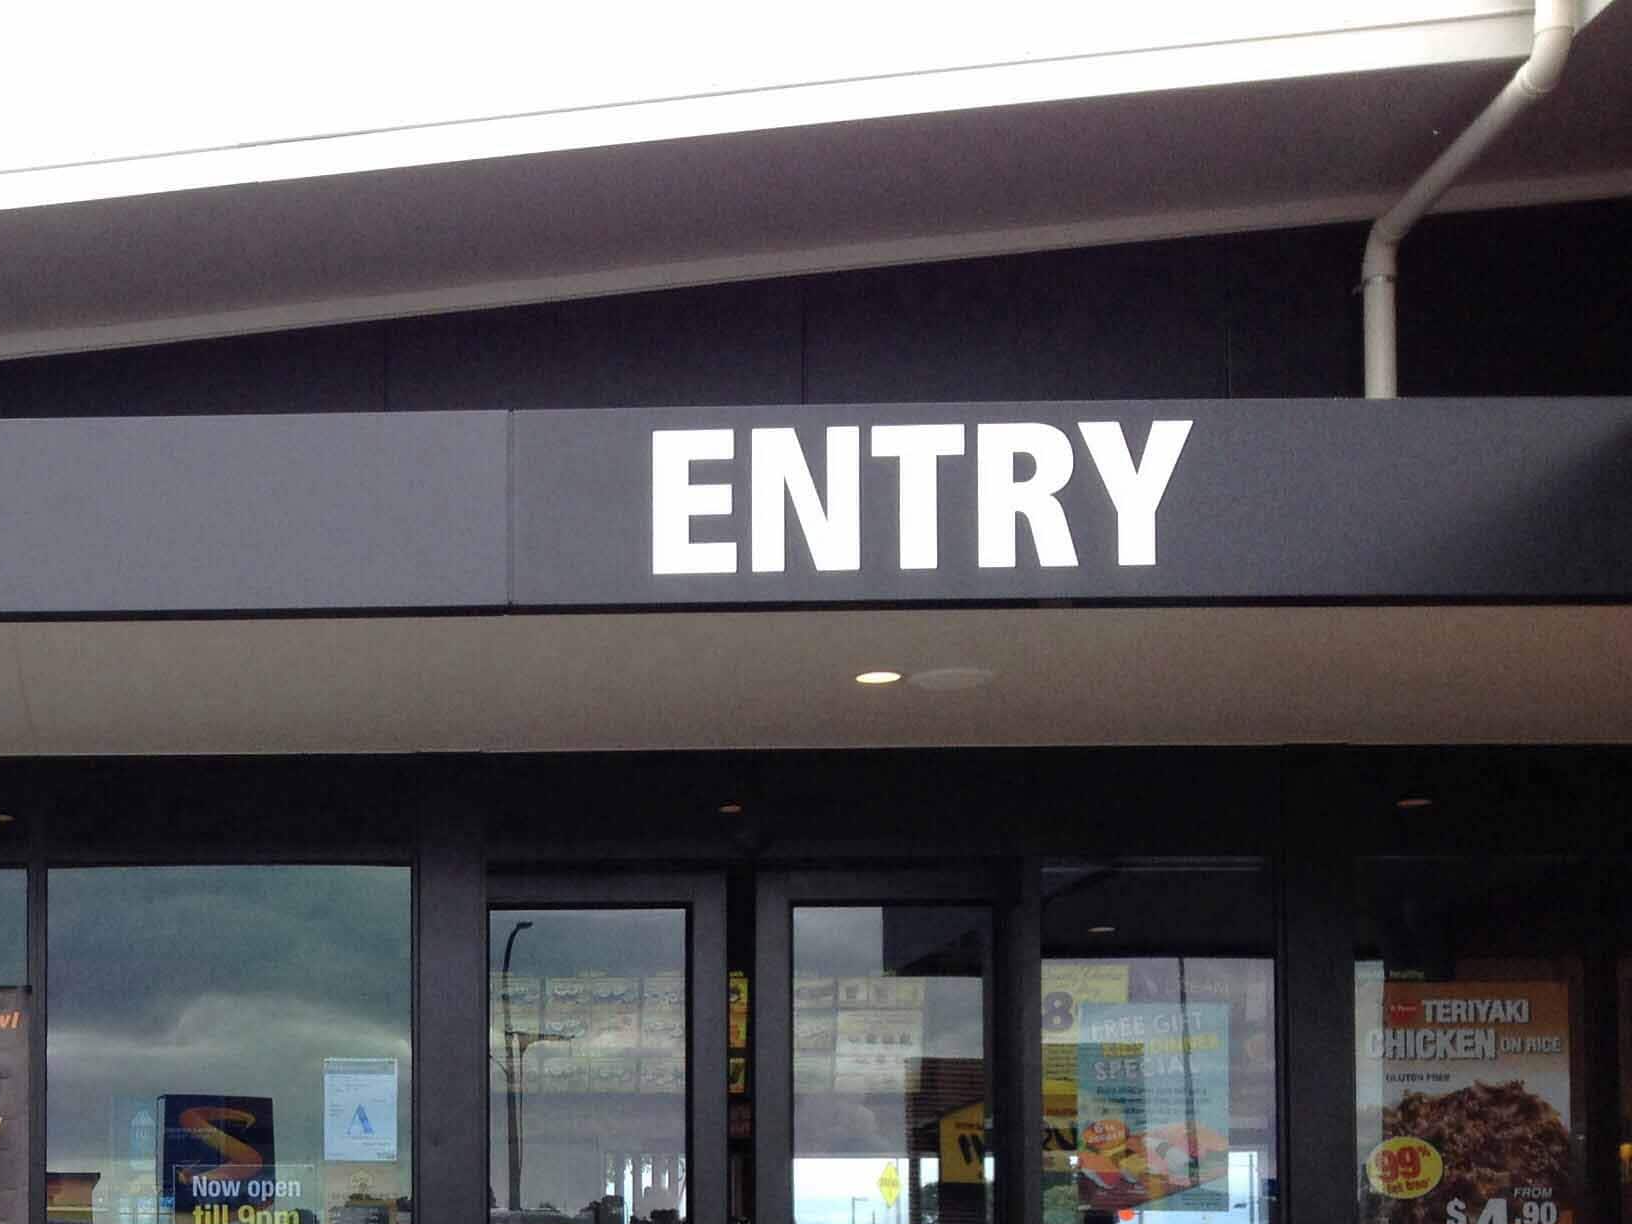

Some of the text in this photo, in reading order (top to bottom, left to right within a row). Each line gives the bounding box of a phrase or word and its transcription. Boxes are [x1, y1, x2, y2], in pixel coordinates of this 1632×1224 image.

[652, 420, 1194, 575] ENTRY
[1423, 1000, 1529, 1024] TERIYAKI
[1368, 1028, 1496, 1059] CHICKEN
[192, 1176, 301, 1200] Now open
[1513, 1187, 1553, 1198] FROM
